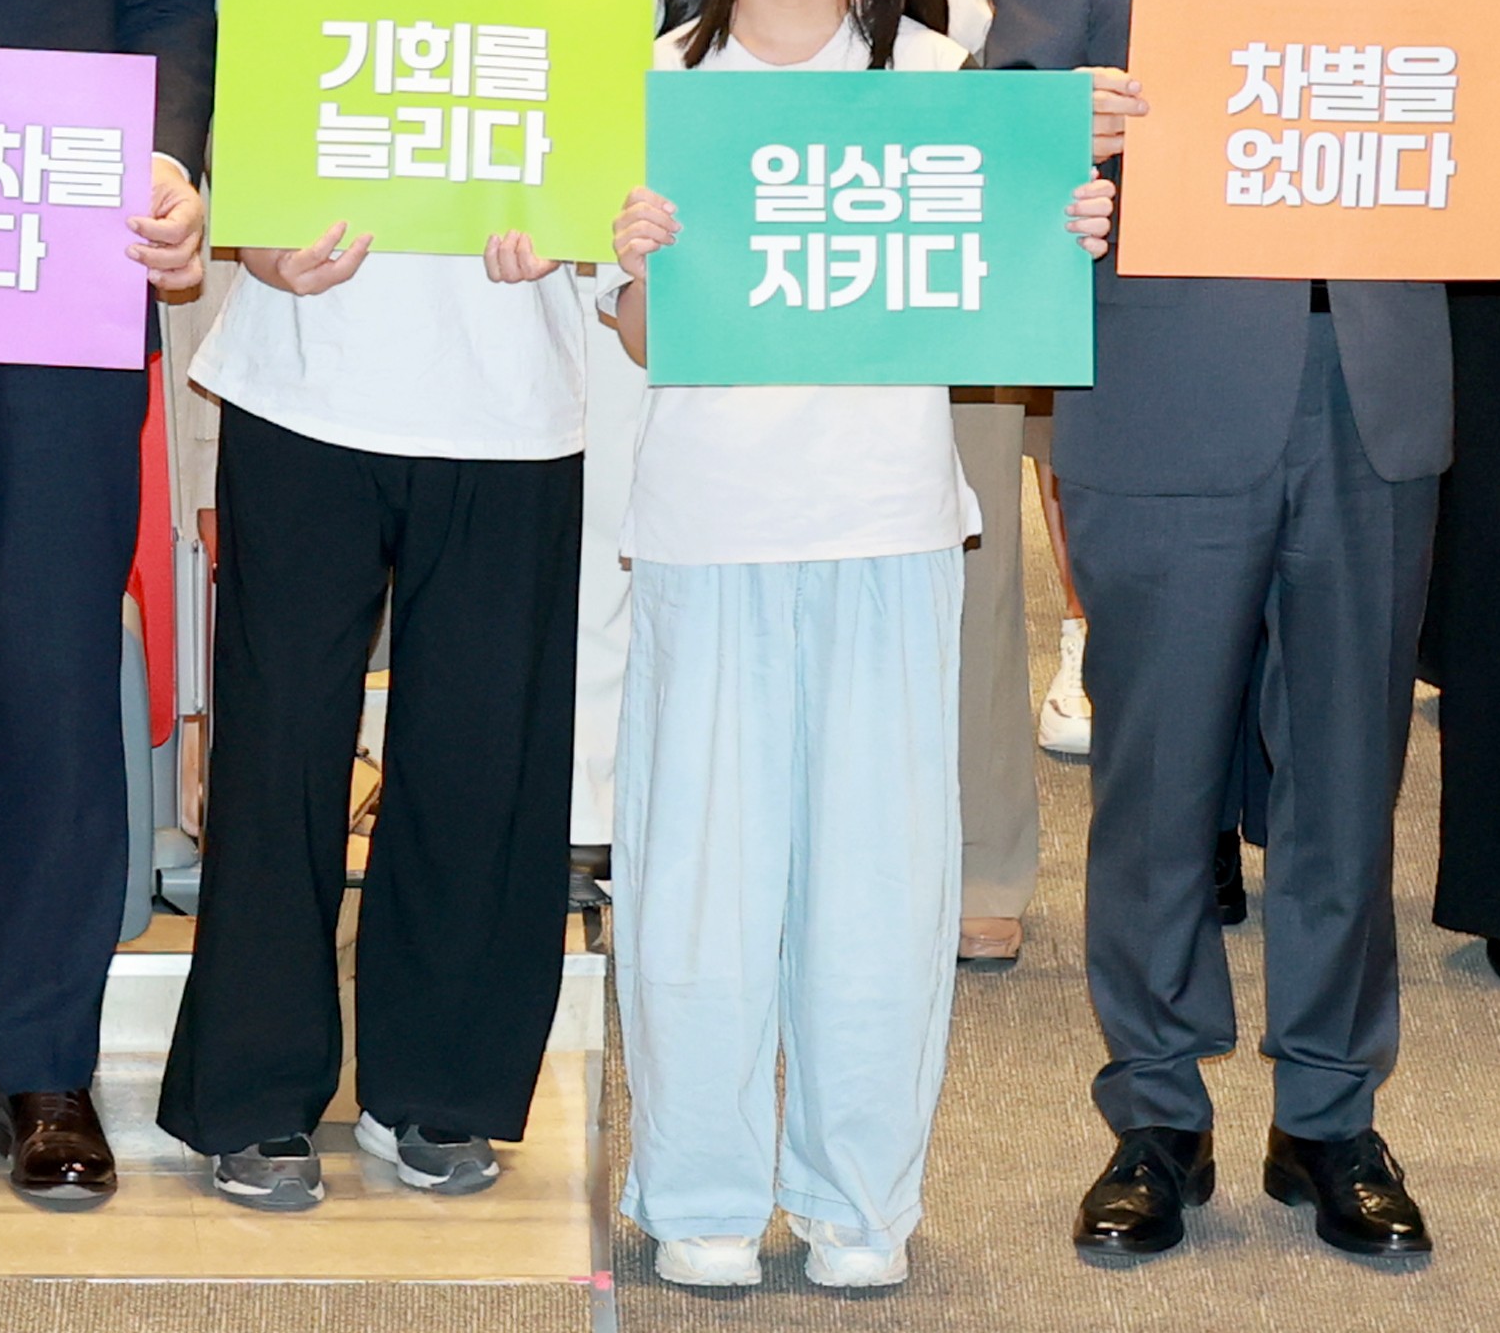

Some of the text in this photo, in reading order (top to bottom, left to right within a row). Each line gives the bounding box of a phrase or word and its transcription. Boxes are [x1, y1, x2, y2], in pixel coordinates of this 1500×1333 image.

[320, 20, 549, 100] 기회를
[1228, 43, 1456, 121] 차별을
[316, 102, 551, 185] 늘리다
[1227, 129, 1455, 207] 없애다
[752, 145, 984, 222] 일상을
[750, 234, 987, 310] 지키다
